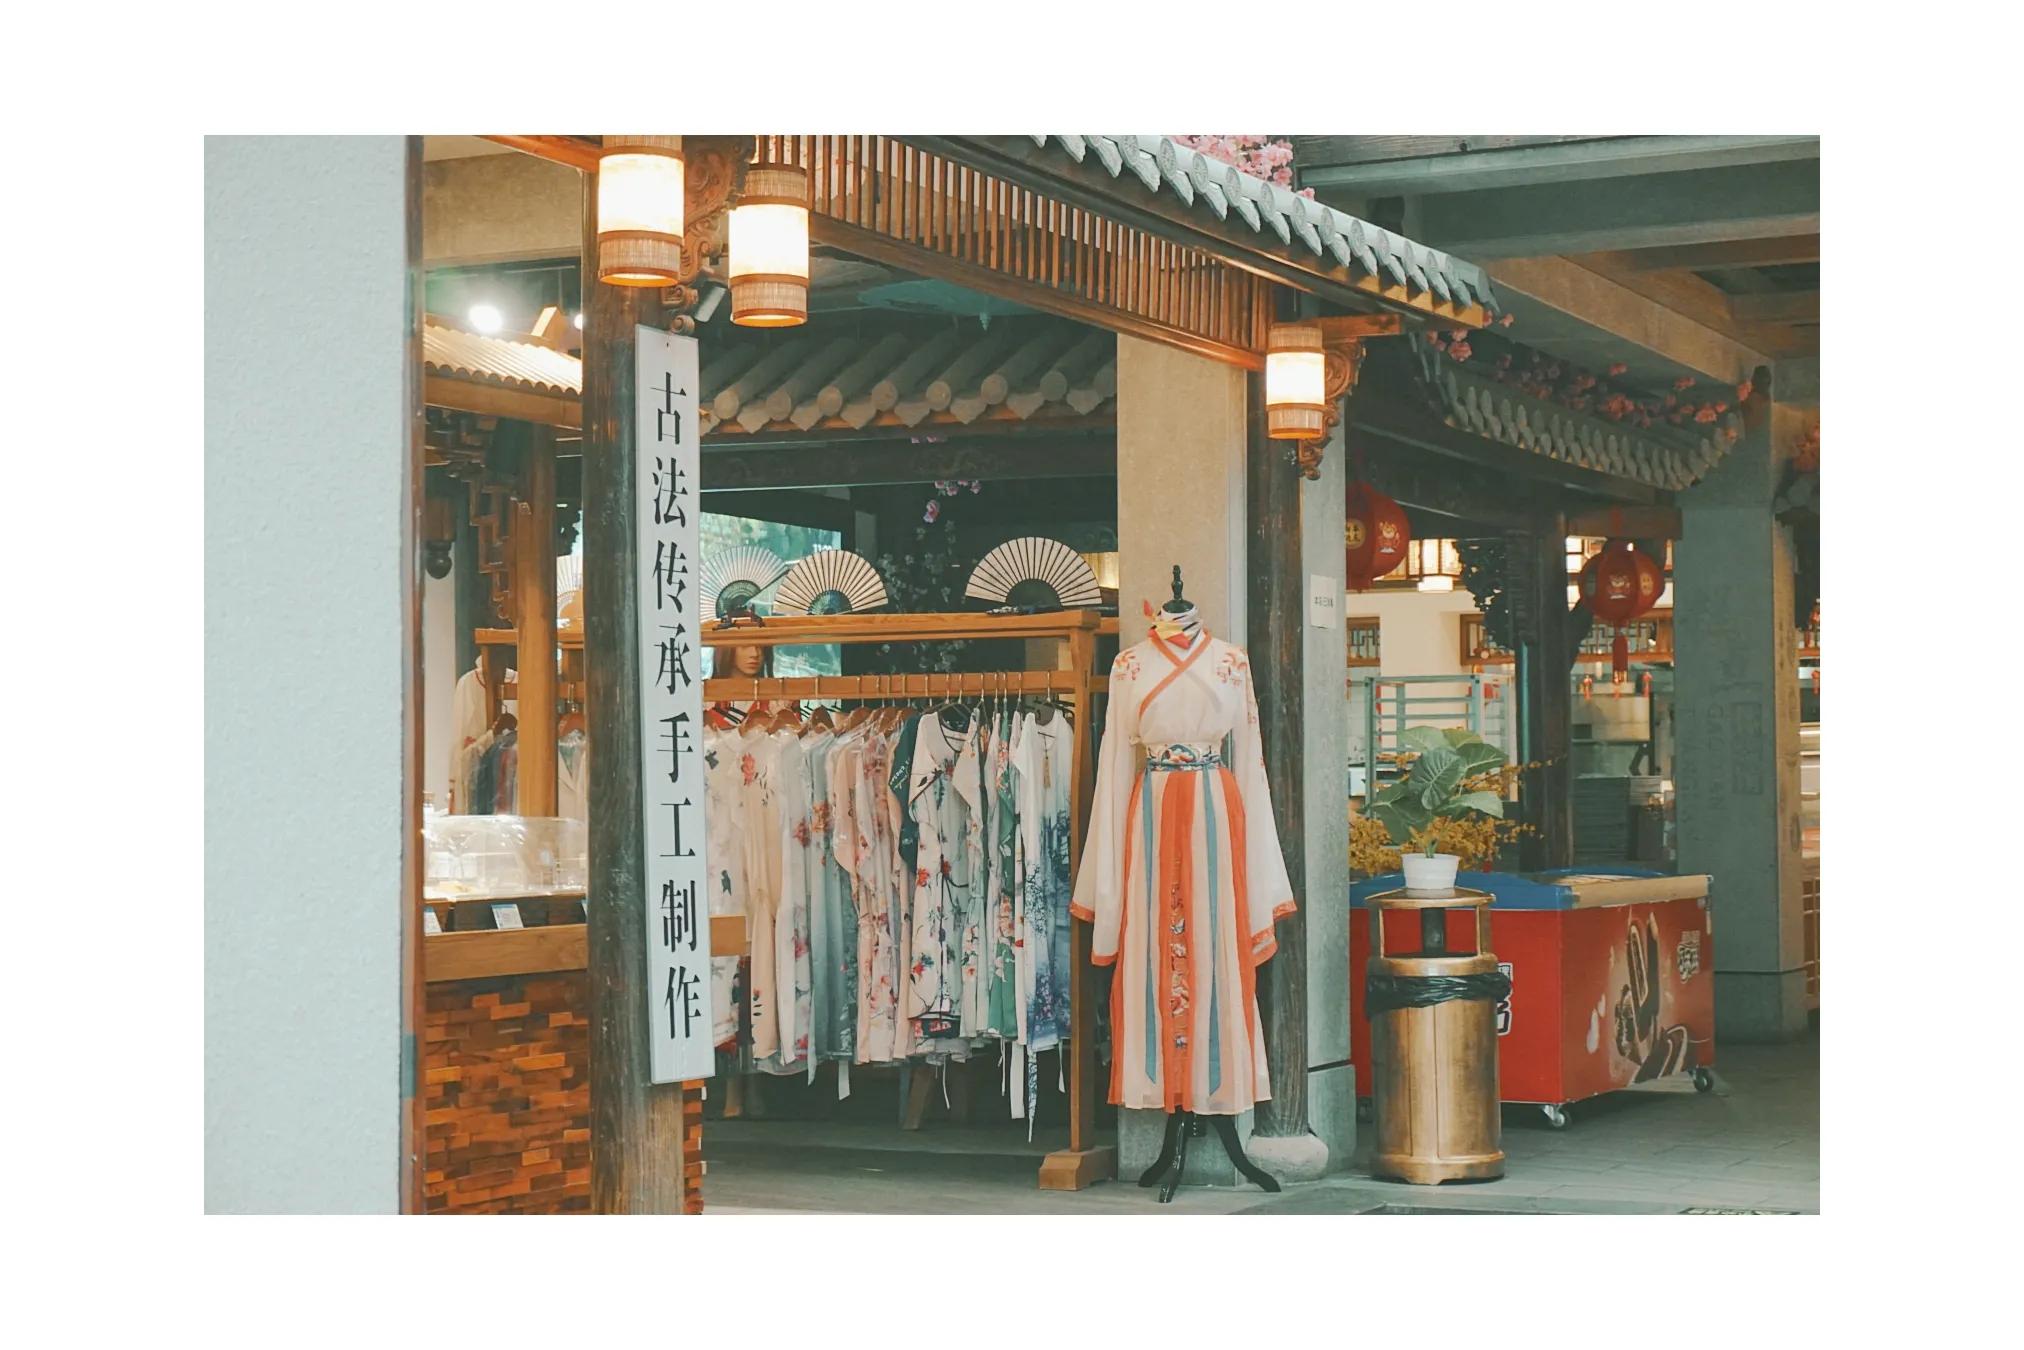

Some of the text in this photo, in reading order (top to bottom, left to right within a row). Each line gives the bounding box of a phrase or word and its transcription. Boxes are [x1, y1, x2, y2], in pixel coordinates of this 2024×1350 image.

[650, 371, 702, 1039] 古法传承手工制作
